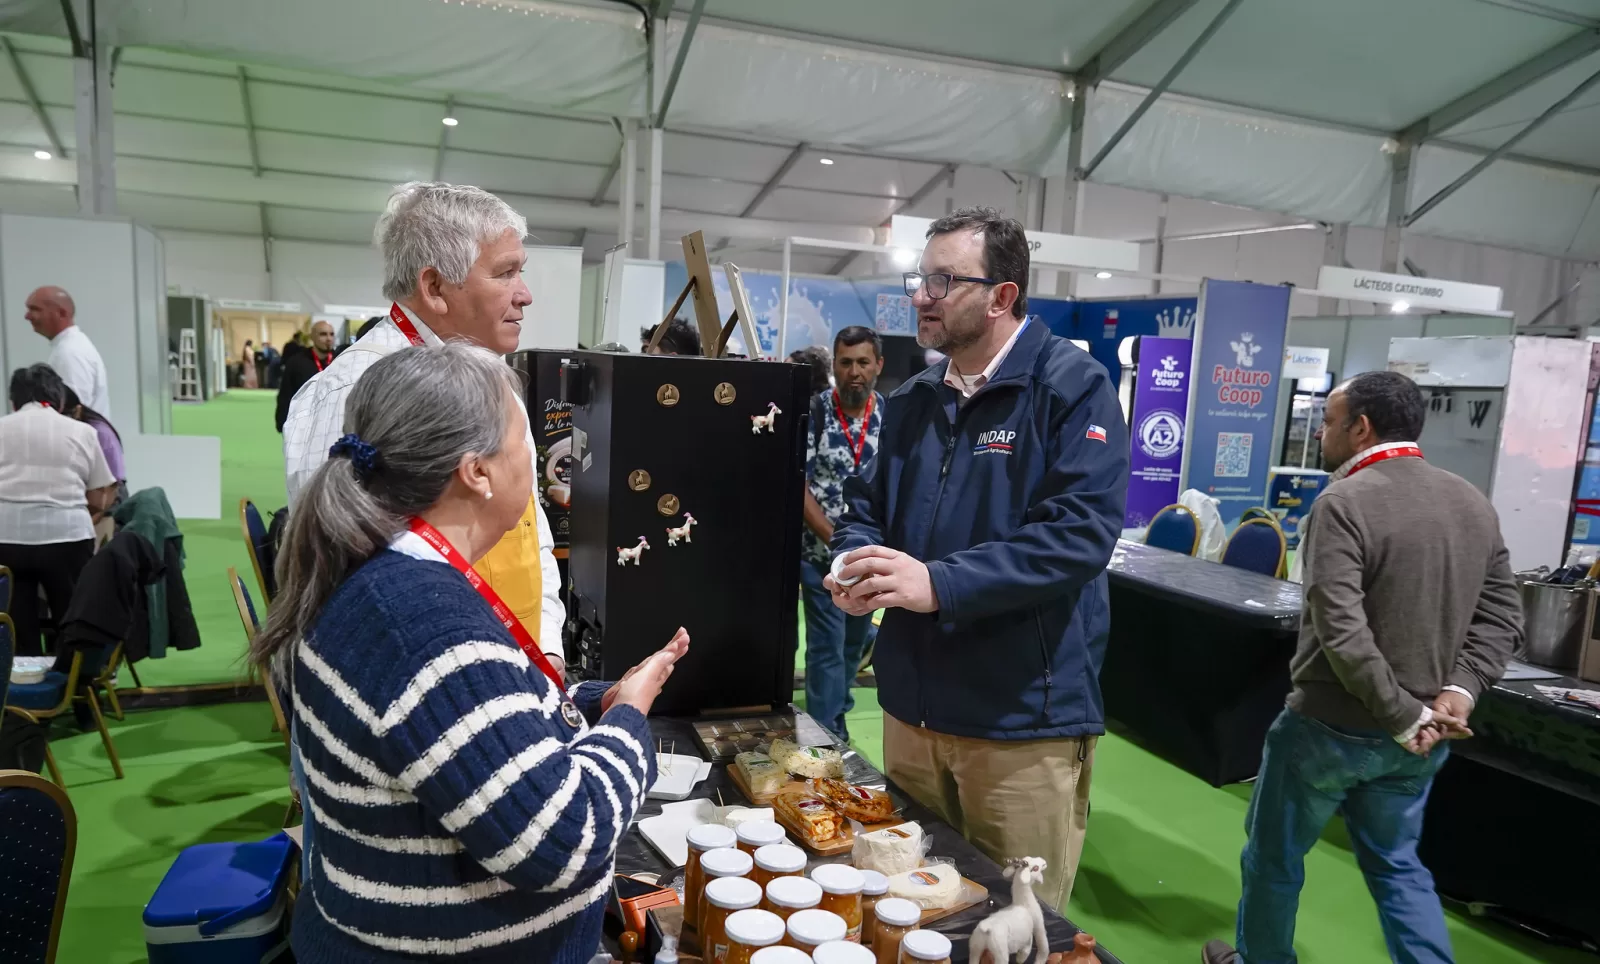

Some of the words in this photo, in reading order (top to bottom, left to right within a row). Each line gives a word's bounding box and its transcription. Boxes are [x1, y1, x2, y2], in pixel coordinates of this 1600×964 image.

[1353, 276, 1393, 293] LÁCTEOS
[1394, 283, 1444, 299] CATATUMBO
[1151, 368, 1185, 379] Futuro
[1212, 364, 1271, 387] Futuro
[1155, 377, 1180, 388] Coop
[1218, 384, 1262, 409] Coop
[976, 429, 1016, 446] INDAP
[1150, 430, 1173, 445] A2
